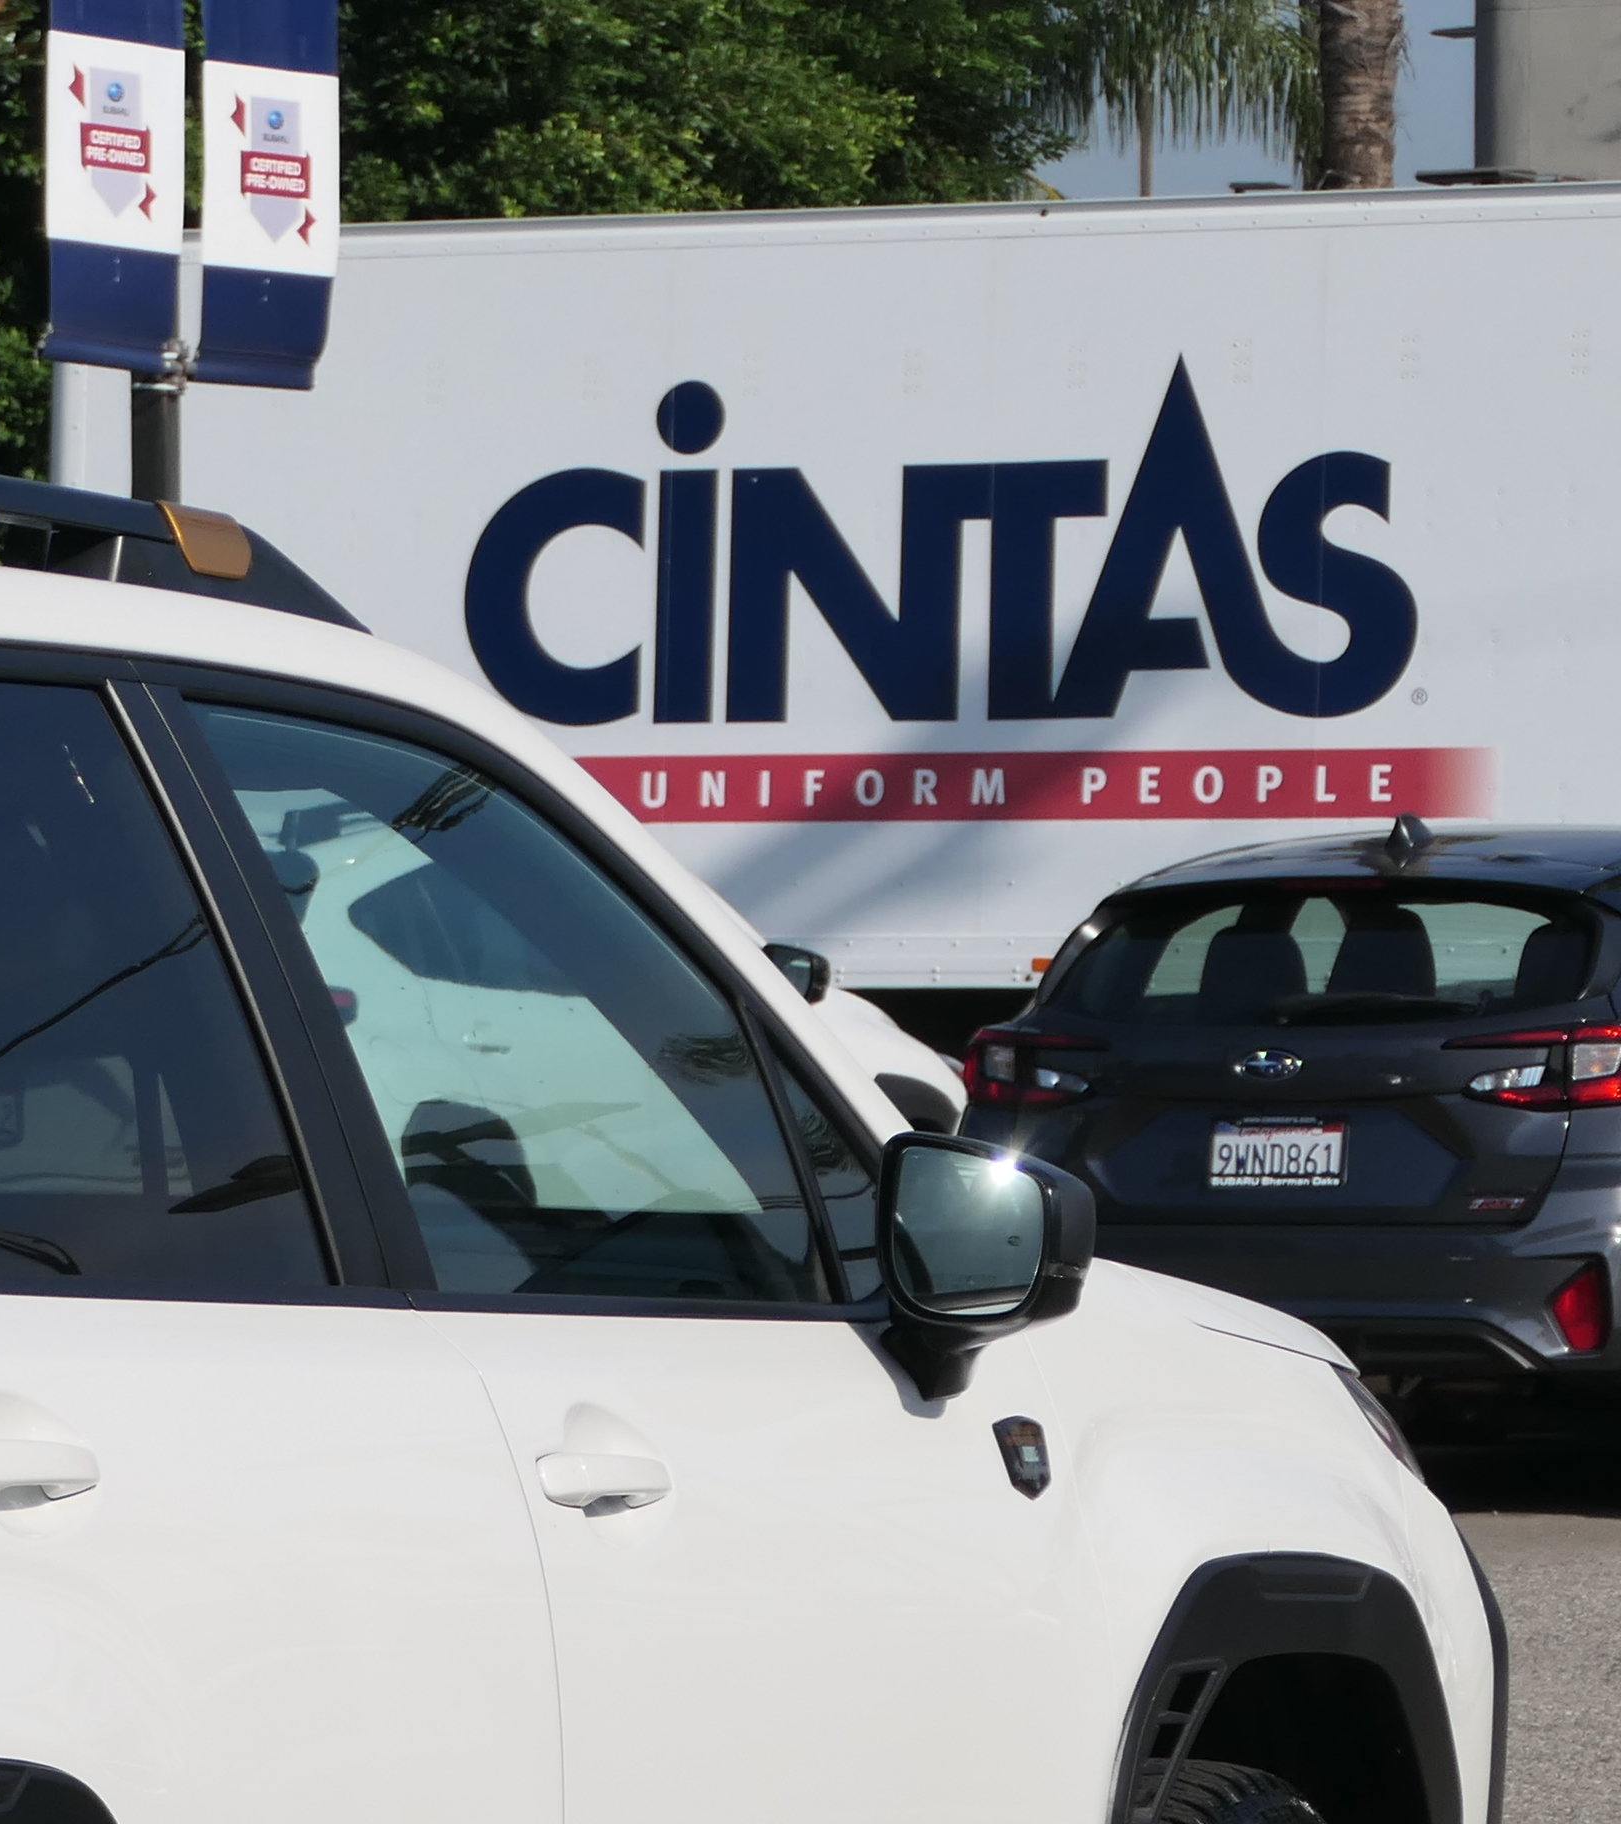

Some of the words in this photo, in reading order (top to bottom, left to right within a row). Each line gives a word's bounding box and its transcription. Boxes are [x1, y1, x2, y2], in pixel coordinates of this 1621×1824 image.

[89, 129, 142, 150] CERTIFIED
[85, 145, 146, 168] PRE-OWNED
[249, 157, 302, 176] CERTIFIED
[245, 173, 306, 194] PRE-OWNED
[640, 768, 1007, 811] UNIFORM
[1081, 763, 1397, 806] PEOPLE
[1218, 1142, 1333, 1175] 9WND861
[1210, 1176, 1260, 1187] SUBARU
[1261, 1176, 1310, 1186] Sherman
[1312, 1176, 1340, 1187] Oaks
